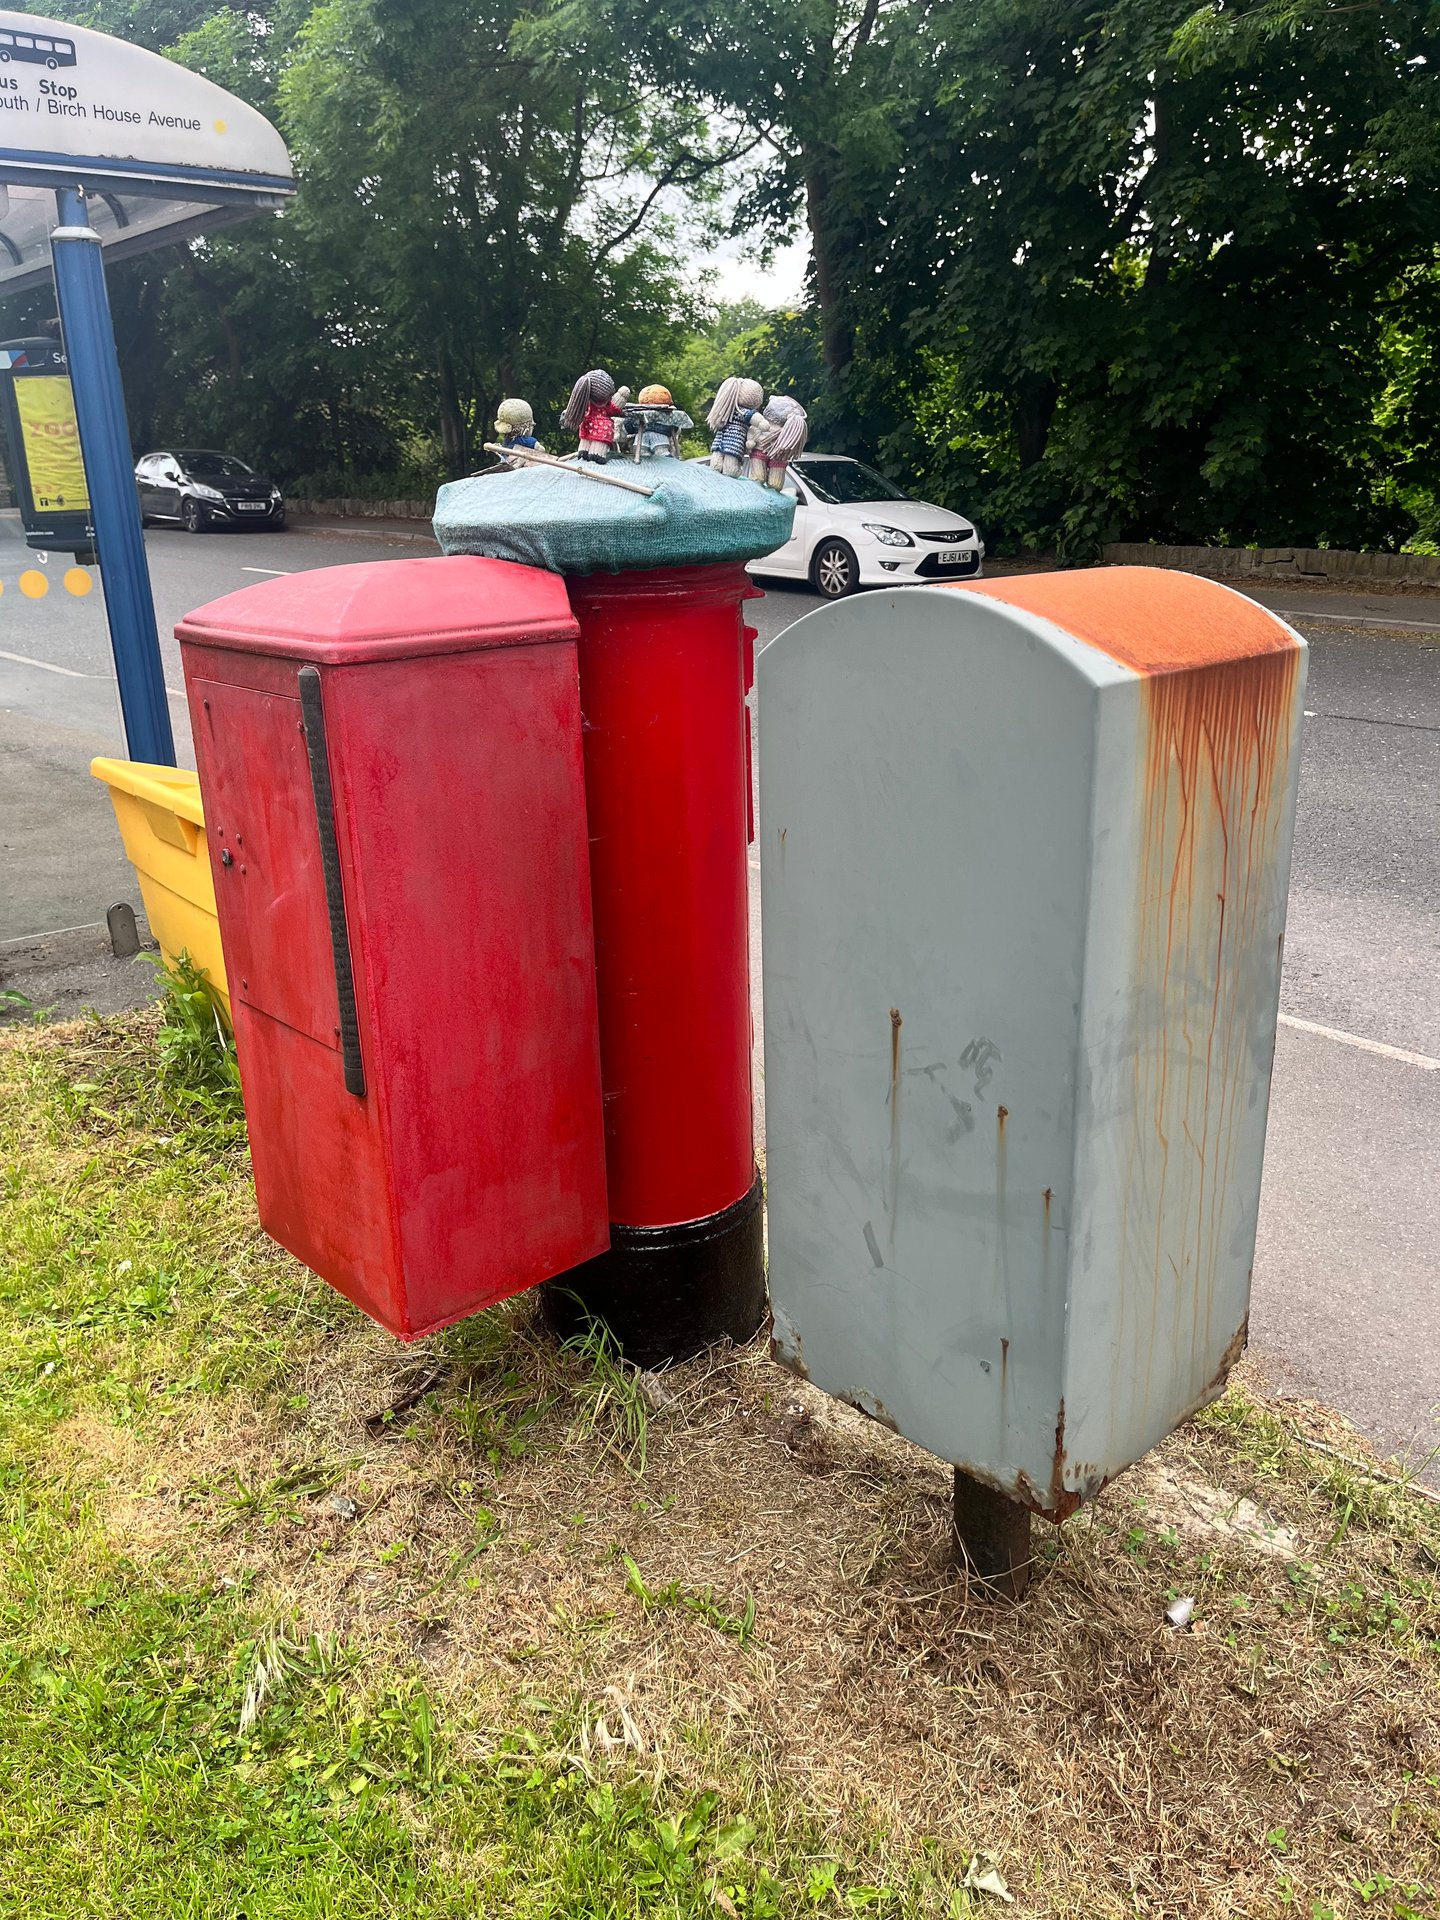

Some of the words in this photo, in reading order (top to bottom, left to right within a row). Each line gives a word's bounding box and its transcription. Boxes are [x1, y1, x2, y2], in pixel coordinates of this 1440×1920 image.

[39, 79, 77, 100] Stop
[47, 99, 87, 117] Birch
[93, 104, 142, 124] House
[148, 111, 201, 131] Avenue
